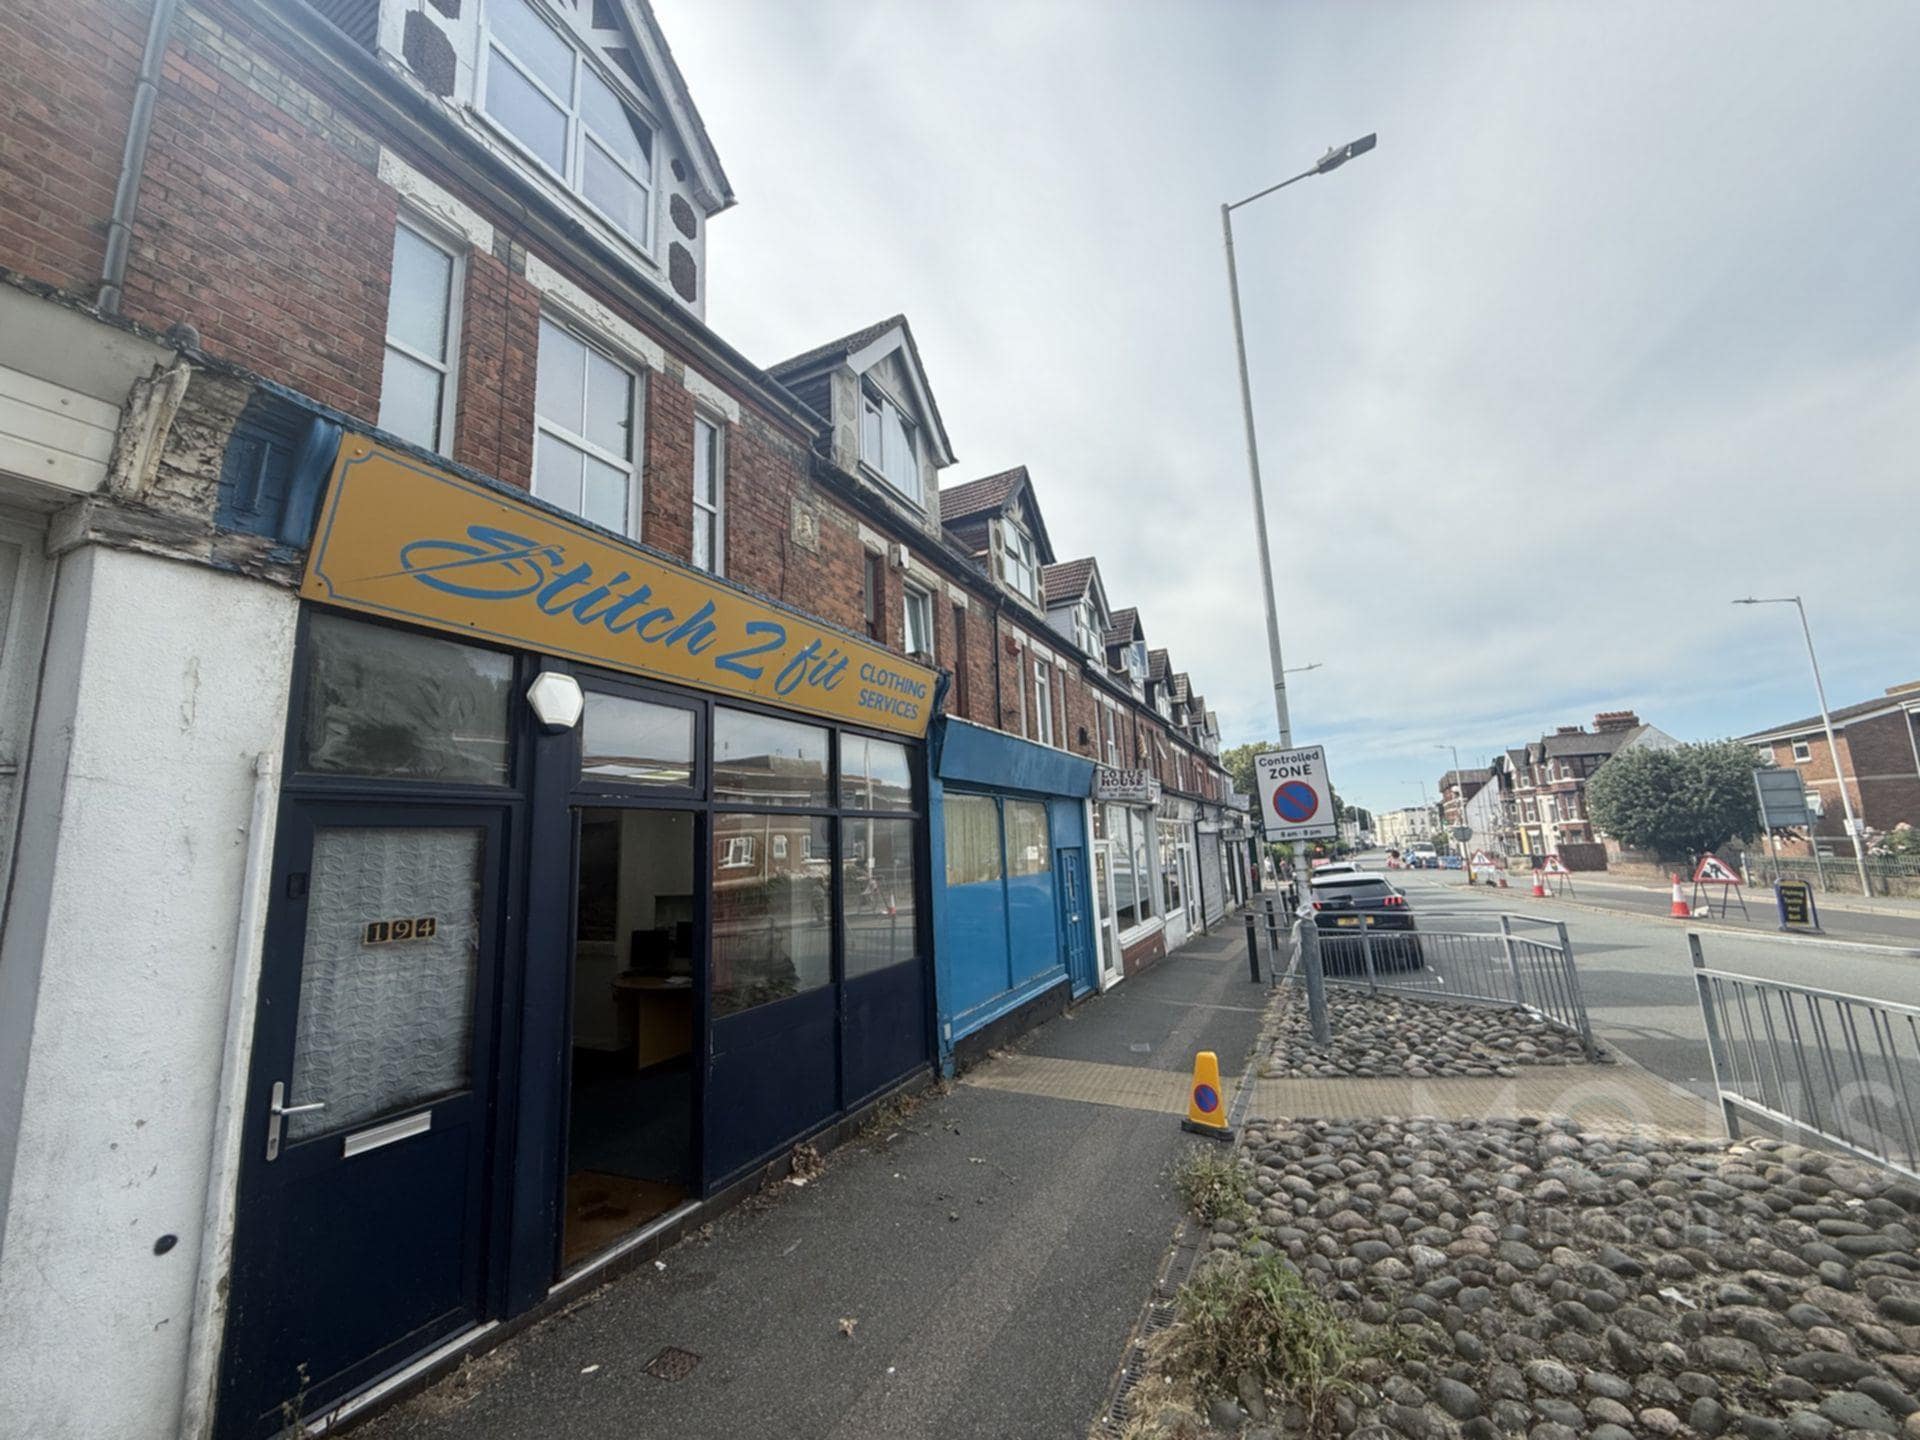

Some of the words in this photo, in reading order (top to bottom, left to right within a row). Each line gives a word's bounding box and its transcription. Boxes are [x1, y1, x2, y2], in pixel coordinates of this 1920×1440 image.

[400, 524, 718, 656] Stitch
[715, 621, 786, 680] 2
[774, 638, 849, 696] fit
[859, 662, 927, 700] CLOTHING
[857, 688, 920, 720] SERVICES
[1259, 751, 1319, 767] Controlled
[1101, 769, 1144, 779] LOTUS
[1269, 764, 1312, 779] ZONE
[1101, 778, 1144, 787] HOUSE
[370, 919, 434, 942] 194
